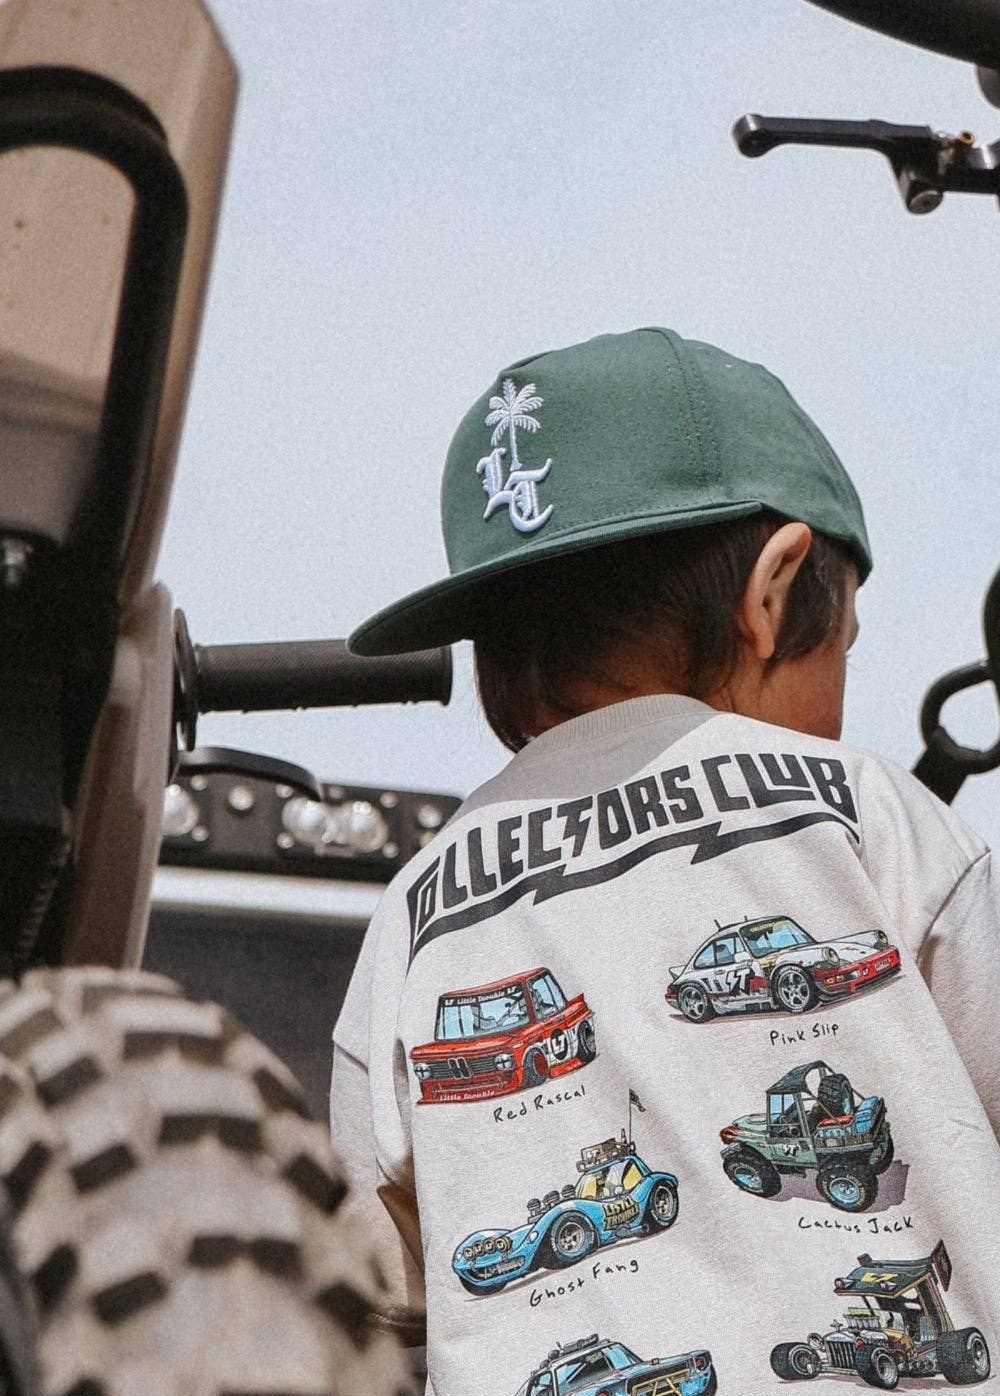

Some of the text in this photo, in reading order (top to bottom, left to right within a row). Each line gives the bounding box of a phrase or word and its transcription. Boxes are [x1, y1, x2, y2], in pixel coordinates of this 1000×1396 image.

[406, 752, 859, 939] COLLECTORS CLUB
[769, 1022, 840, 1046] Pink Slip
[493, 1084, 586, 1123] Red Rascal
[798, 1216, 914, 1234] Cactus Jack
[529, 1259, 640, 1308] Ghost Fang
